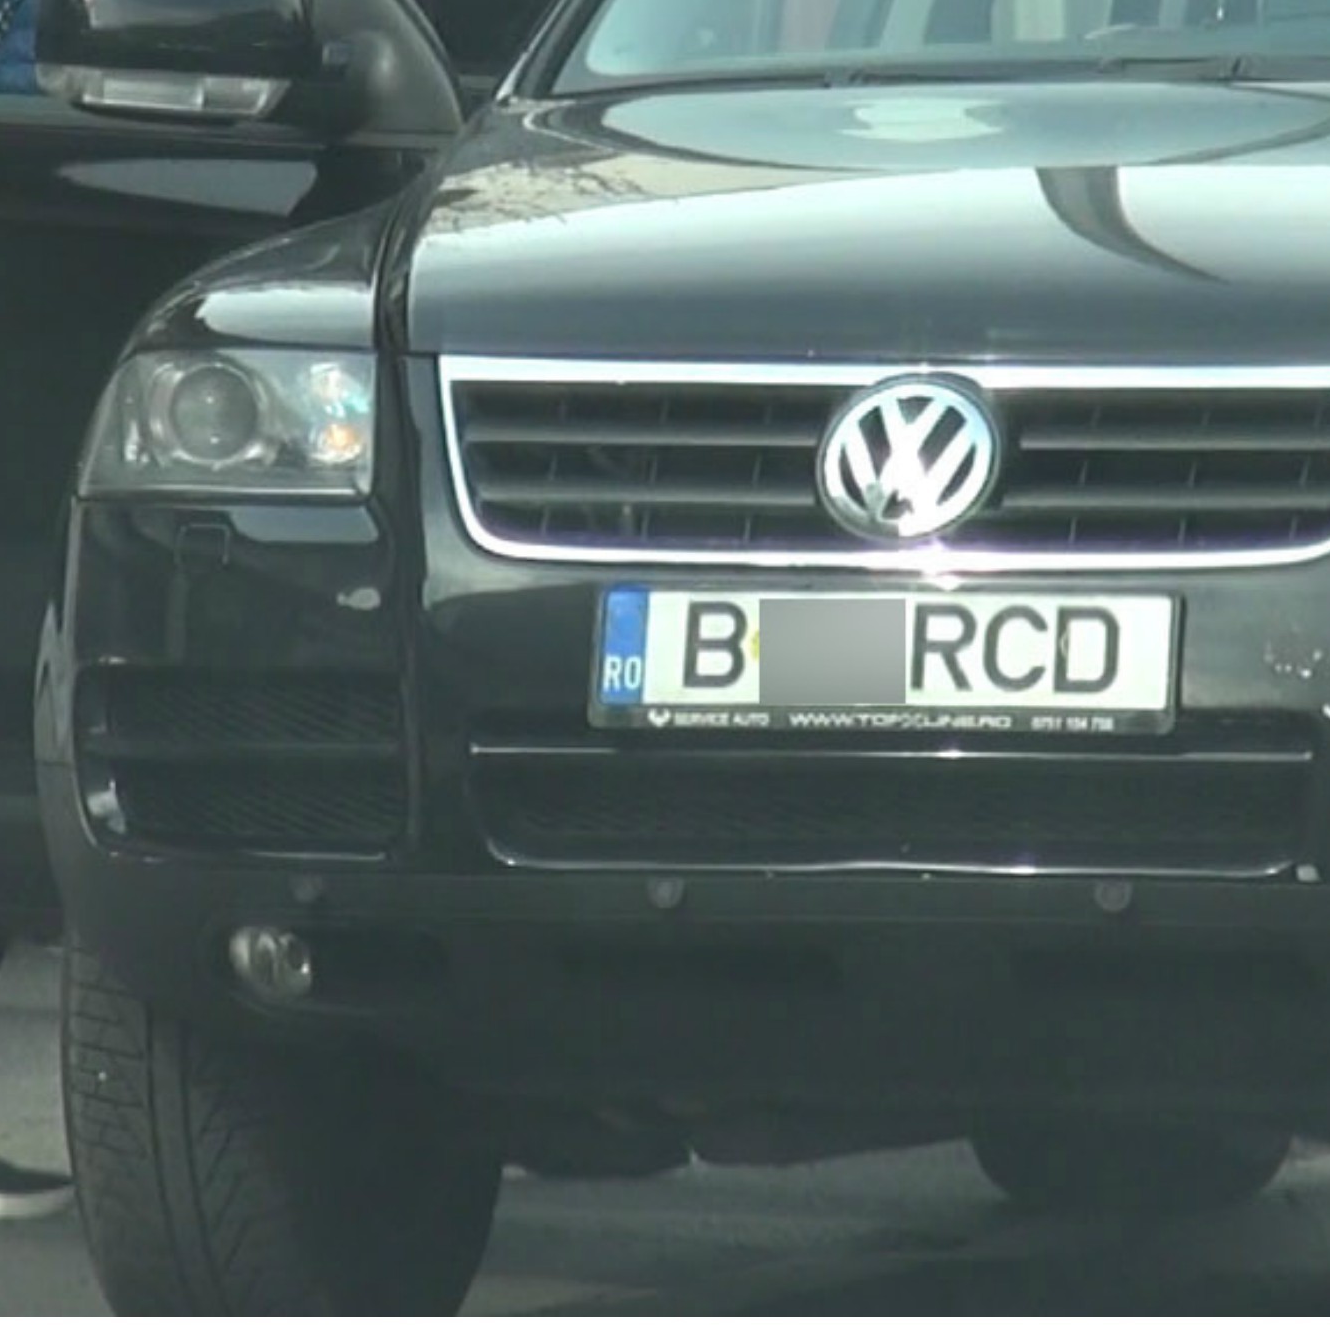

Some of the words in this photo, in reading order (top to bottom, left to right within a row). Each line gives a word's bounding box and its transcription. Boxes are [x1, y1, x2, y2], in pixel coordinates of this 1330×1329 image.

[602, 654, 643, 691] RO
[681, 600, 749, 690] B
[909, 602, 1121, 694] RCD
